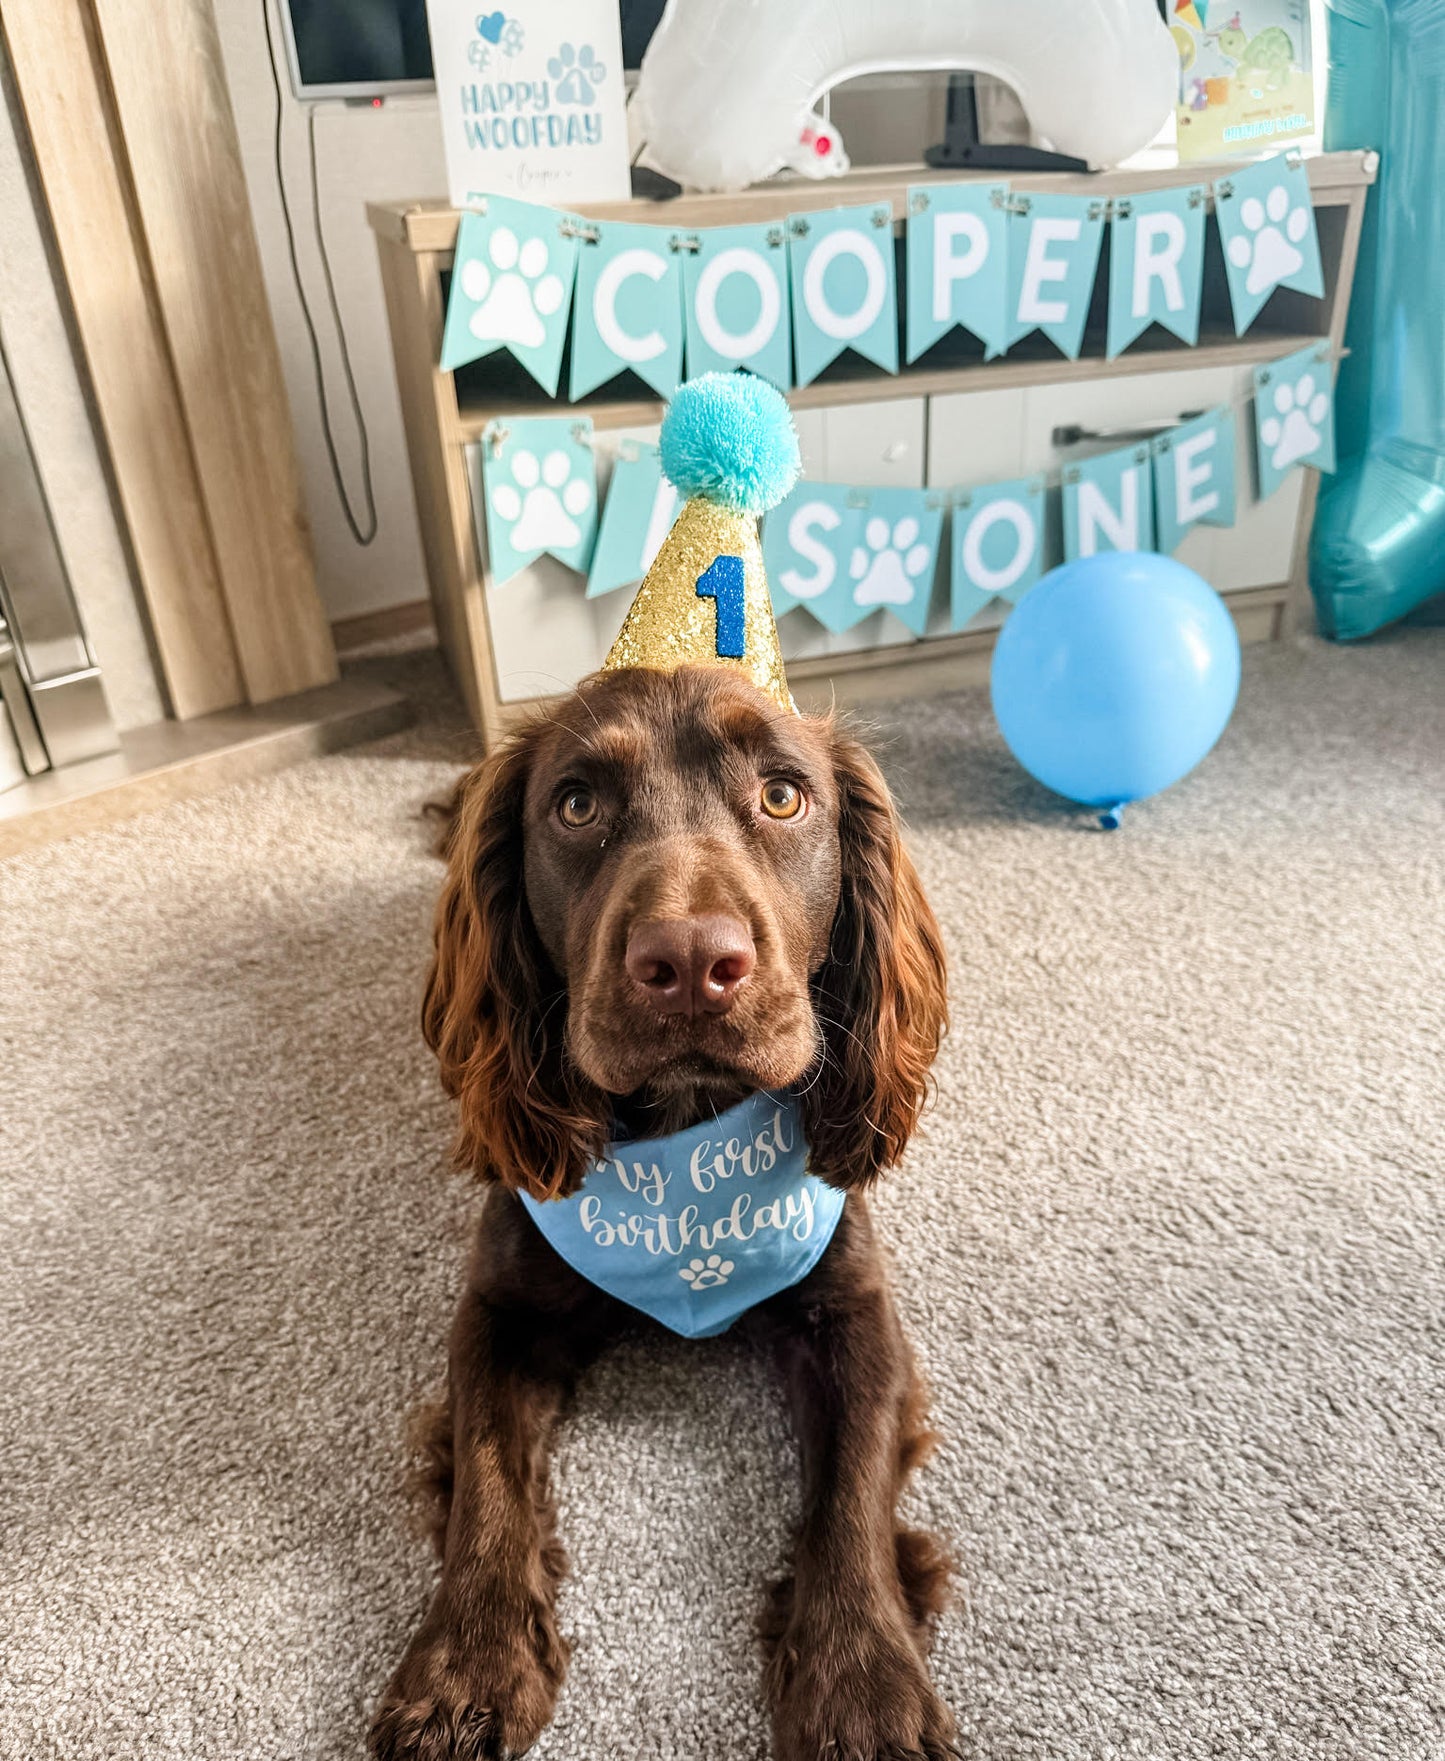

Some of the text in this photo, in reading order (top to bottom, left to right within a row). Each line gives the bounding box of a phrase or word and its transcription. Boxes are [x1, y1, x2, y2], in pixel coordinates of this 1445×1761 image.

[460, 80, 550, 114] HAPPY
[463, 113, 602, 150] WOOFDAY
[593, 211, 1186, 362] COOPER
[962, 427, 1219, 591] ONE
[696, 555, 745, 658] 1
[690, 1109, 794, 1193] first
[579, 1186, 818, 1255] birthday
